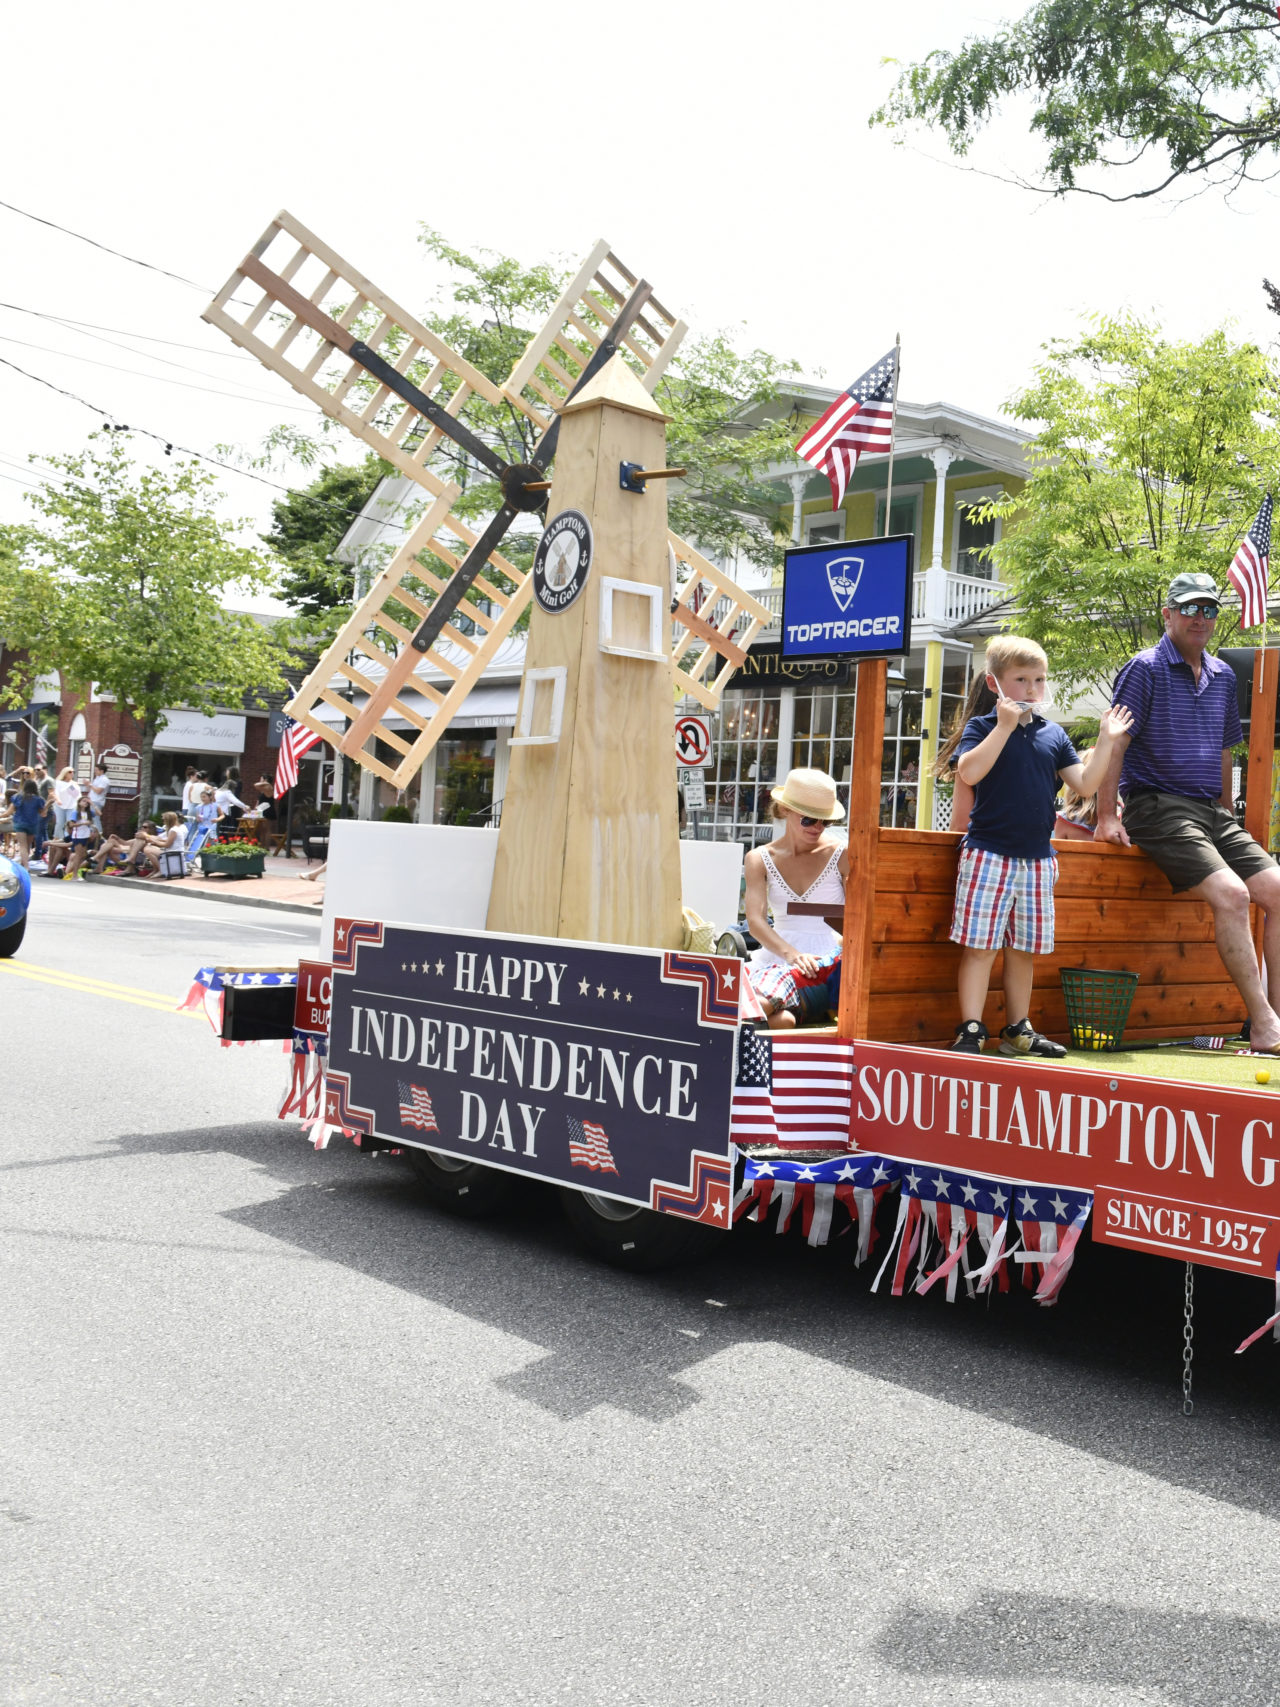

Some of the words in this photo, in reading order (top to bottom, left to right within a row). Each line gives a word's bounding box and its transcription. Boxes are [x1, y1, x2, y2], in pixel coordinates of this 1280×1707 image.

[544, 516, 586, 547] HAMPTONS
[539, 584, 558, 607] Mini
[559, 578, 580, 605] Golf
[787, 615, 900, 643] TOPTRACER
[201, 726, 240, 739] Miller
[453, 950, 568, 1006] HAPPY
[348, 1005, 698, 1122] INDEPENDENCE
[458, 1089, 546, 1158] DAY
[857, 1064, 1221, 1179] SOUTHAMPTON
[1106, 1198, 1191, 1241] SINCE
[1200, 1215, 1266, 1255] 1957
